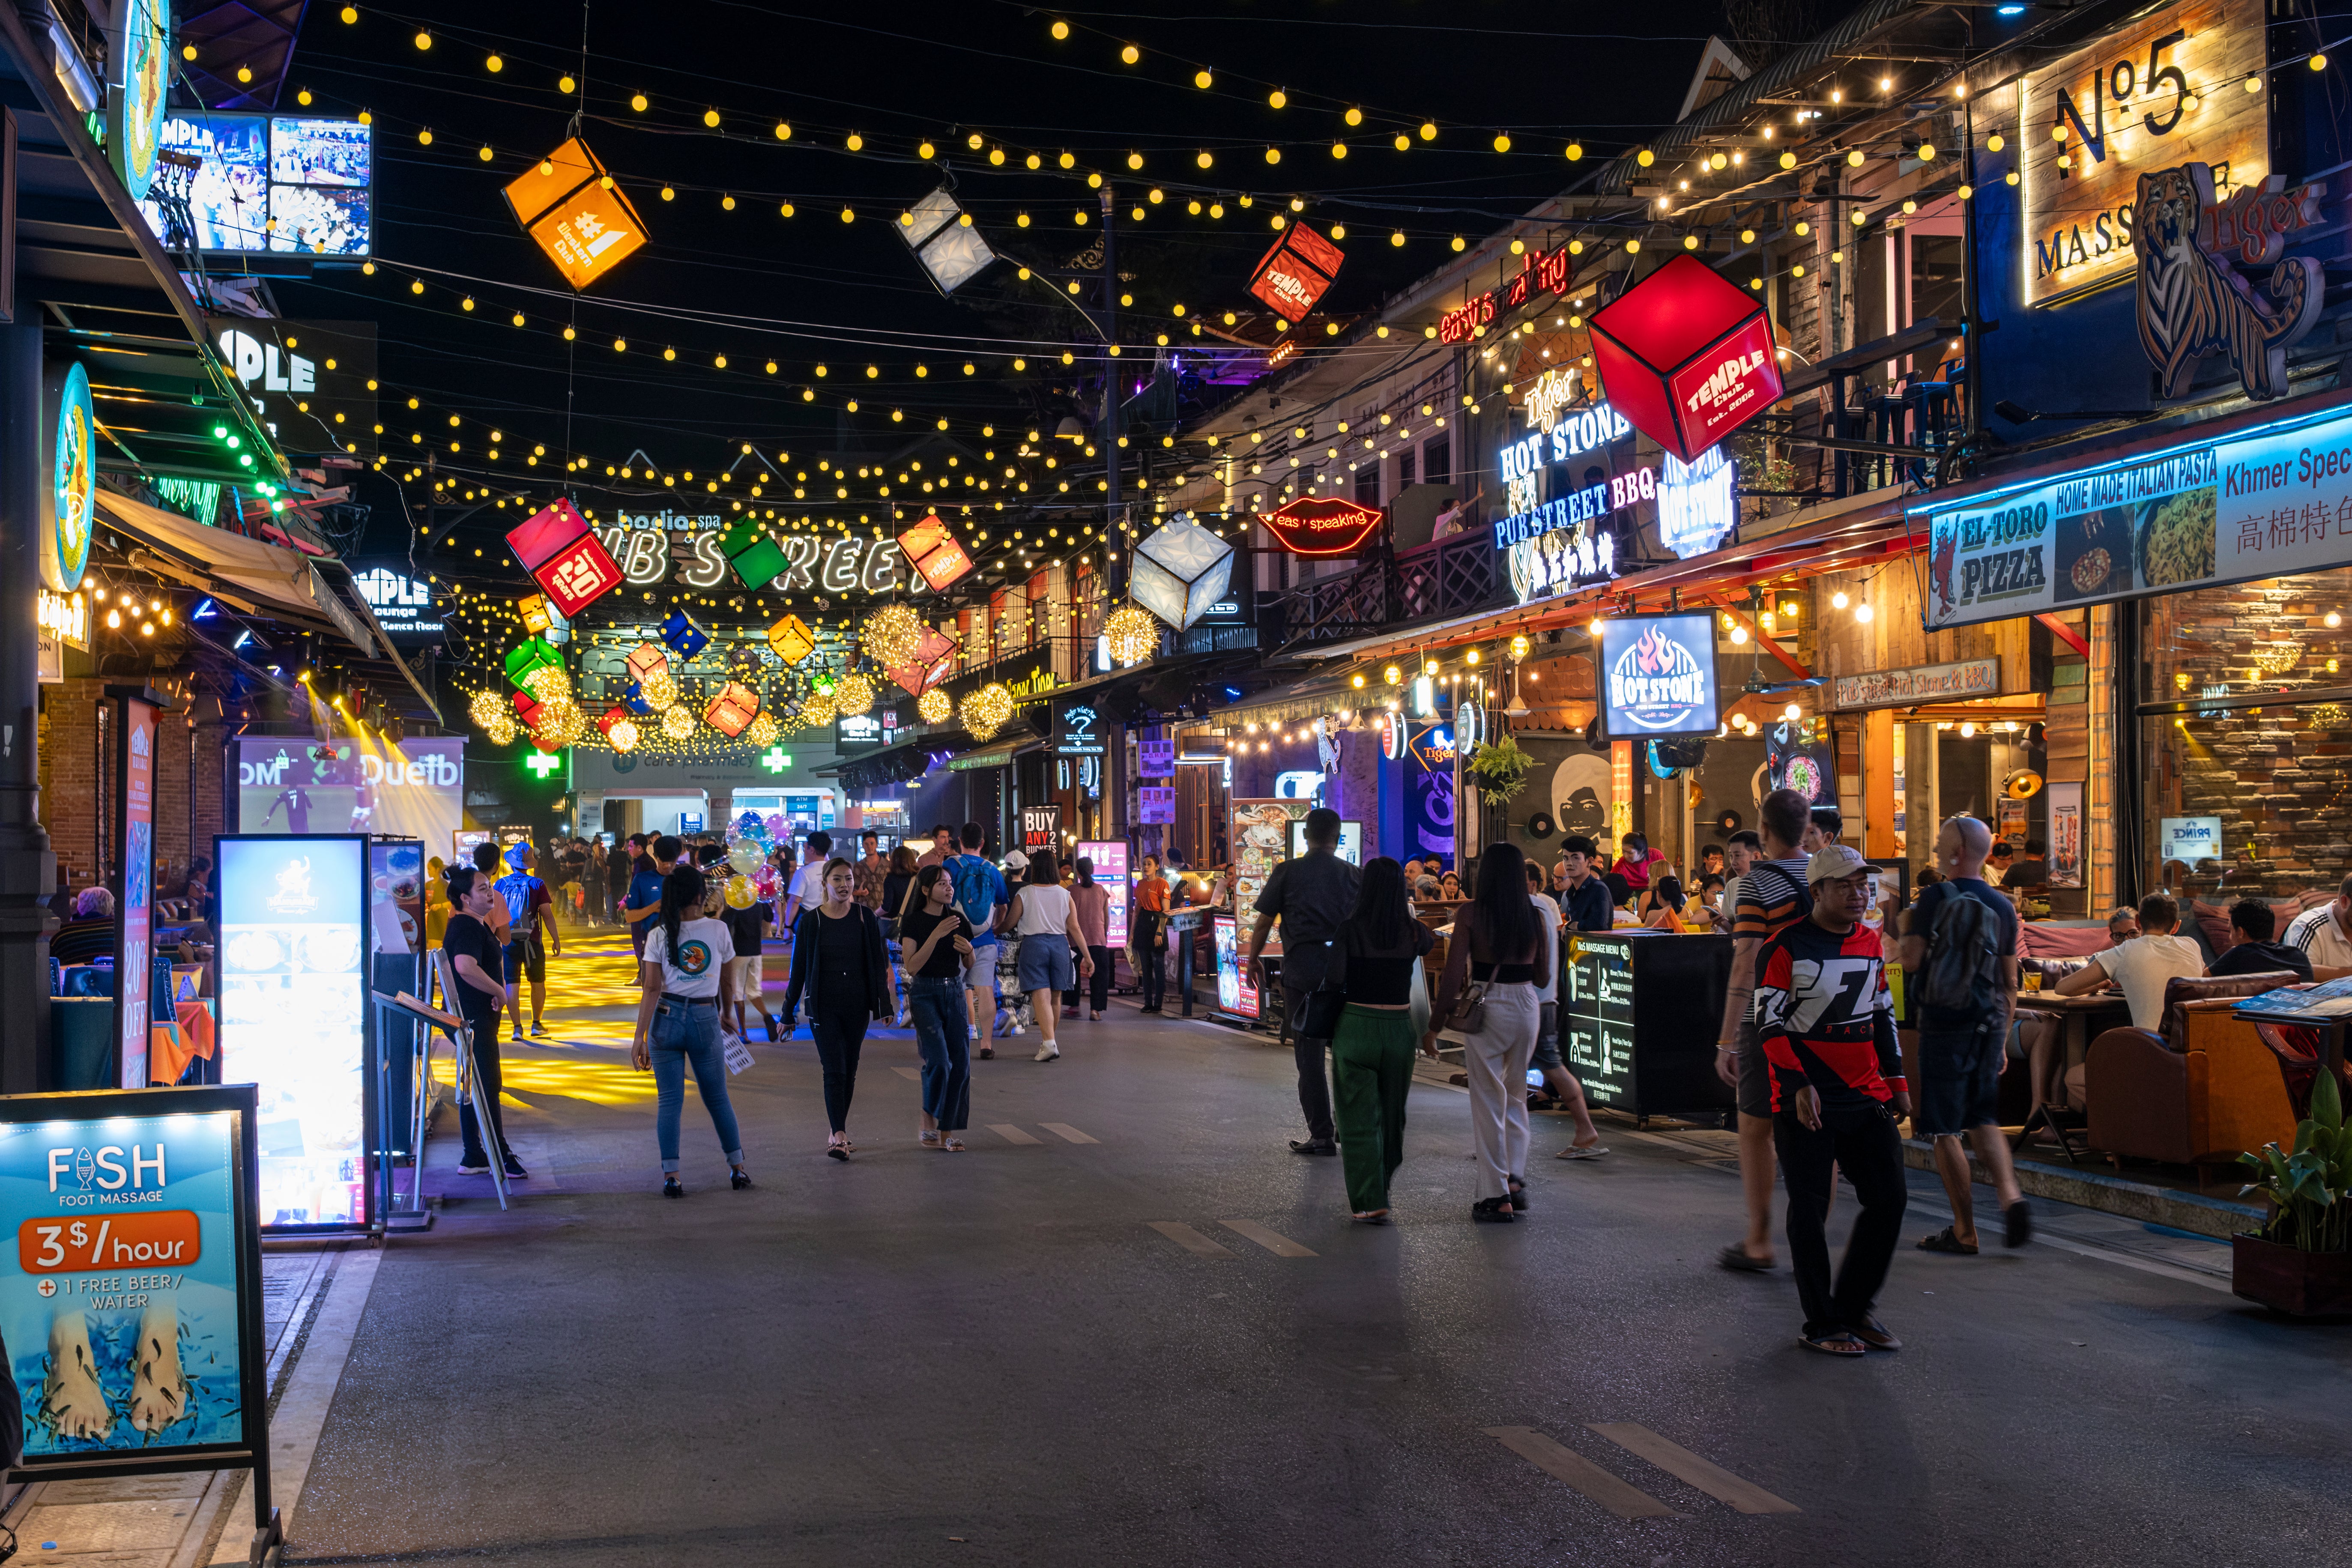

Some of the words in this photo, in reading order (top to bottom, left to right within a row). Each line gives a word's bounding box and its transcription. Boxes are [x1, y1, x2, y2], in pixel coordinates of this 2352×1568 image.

[2035, 160, 2232, 281] MASSE
[2204, 175, 2321, 265] Tiger
[557, 221, 592, 268] Western
[574, 211, 628, 259] #1
[553, 239, 574, 265] Club
[1267, 270, 1312, 307] TEMPLE
[1274, 288, 1292, 303] Club
[1688, 349, 1765, 412] TEMPLE
[1525, 368, 1575, 435] Tiger
[1713, 382, 1744, 407] Club
[1728, 388, 1755, 412] 2002
[1500, 436, 1542, 484] HOT
[1553, 403, 1629, 462] STONE
[2056, 483, 2088, 517] HOME
[2091, 475, 2125, 509] MADE
[2126, 464, 2176, 499] ITALIAN
[2178, 451, 2218, 488] PASTA
[2226, 459, 2294, 499] Khmer
[618, 508, 689, 531] bodia
[698, 515, 720, 531] spa
[1495, 514, 1528, 549] PUB
[1532, 484, 1607, 537] STREET
[1611, 467, 1656, 509] BBQ
[1310, 511, 1368, 532] speaking
[1960, 502, 2048, 553] EL-TORO
[686, 530, 928, 593] SREE
[928, 552, 962, 579] TEMPLE
[557, 555, 600, 597] 20
[1960, 546, 2046, 606] PIZZA
[369, 605, 418, 618] ounge
[415, 621, 444, 632] Floor
[1610, 673, 1649, 708] HOT
[1650, 670, 1705, 705] STONE
[1950, 669, 1962, 690] &
[1964, 665, 1991, 689] BBQ
[719, 709, 743, 729] TEMPLE
[131, 724, 149, 757] TEMPLE
[644, 756, 675, 767] care
[683, 754, 754, 769] pharmacy
[1423, 747, 1454, 762] Tiger
[290, 794, 297, 809] 7
[1025, 812, 1055, 831] BUY
[504, 833, 524, 841] TEMPLE
[1026, 831, 1048, 845] ANY
[1049, 831, 1056, 845] 2
[1578, 942, 1586, 950] No5
[1586, 943, 1605, 953] MASSAGE
[1605, 945, 1619, 955] MENU
[125, 939, 147, 995] 20%
[1886, 968, 1901, 977] erry
[124, 1000, 147, 1039] OFF
[60, 1193, 95, 1207] FOOT
[101, 1191, 163, 1204] MASSAGE
[64, 1280, 72, 1294] 1
[79, 1278, 123, 1294] FREE
[128, 1274, 183, 1291] BEER/
[90, 1294, 149, 1311] WATER
